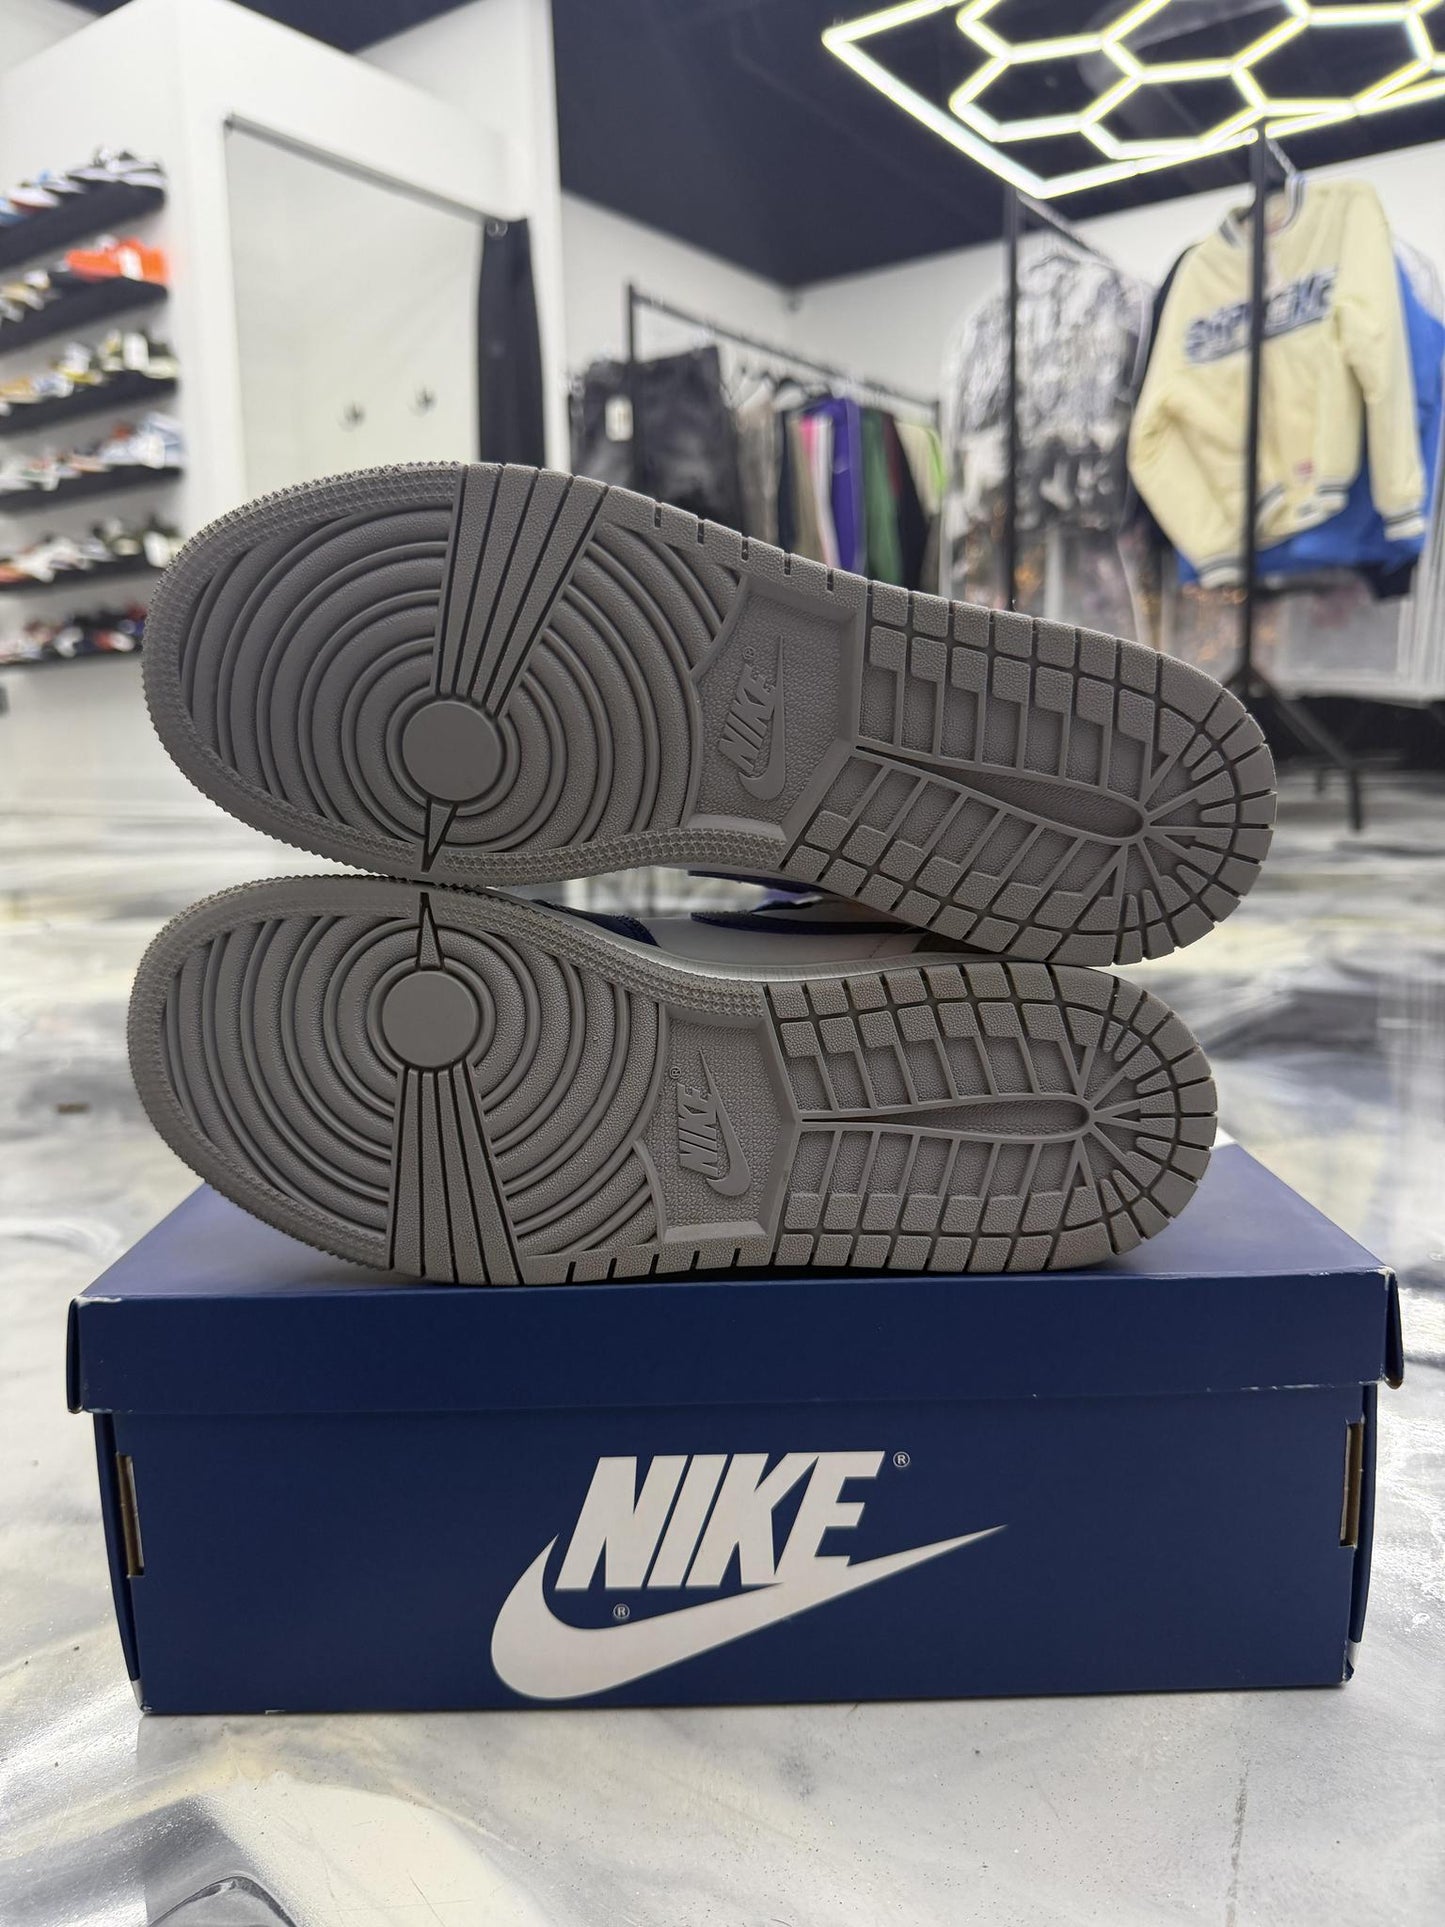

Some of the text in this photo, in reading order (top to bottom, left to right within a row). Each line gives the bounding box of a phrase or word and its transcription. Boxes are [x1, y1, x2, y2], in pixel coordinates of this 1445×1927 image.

[1185, 270, 1337, 363] SUPME
[718, 663, 777, 773] NIKE
[672, 1082, 719, 1177] NIKE
[555, 1451, 885, 1591] NIKE
